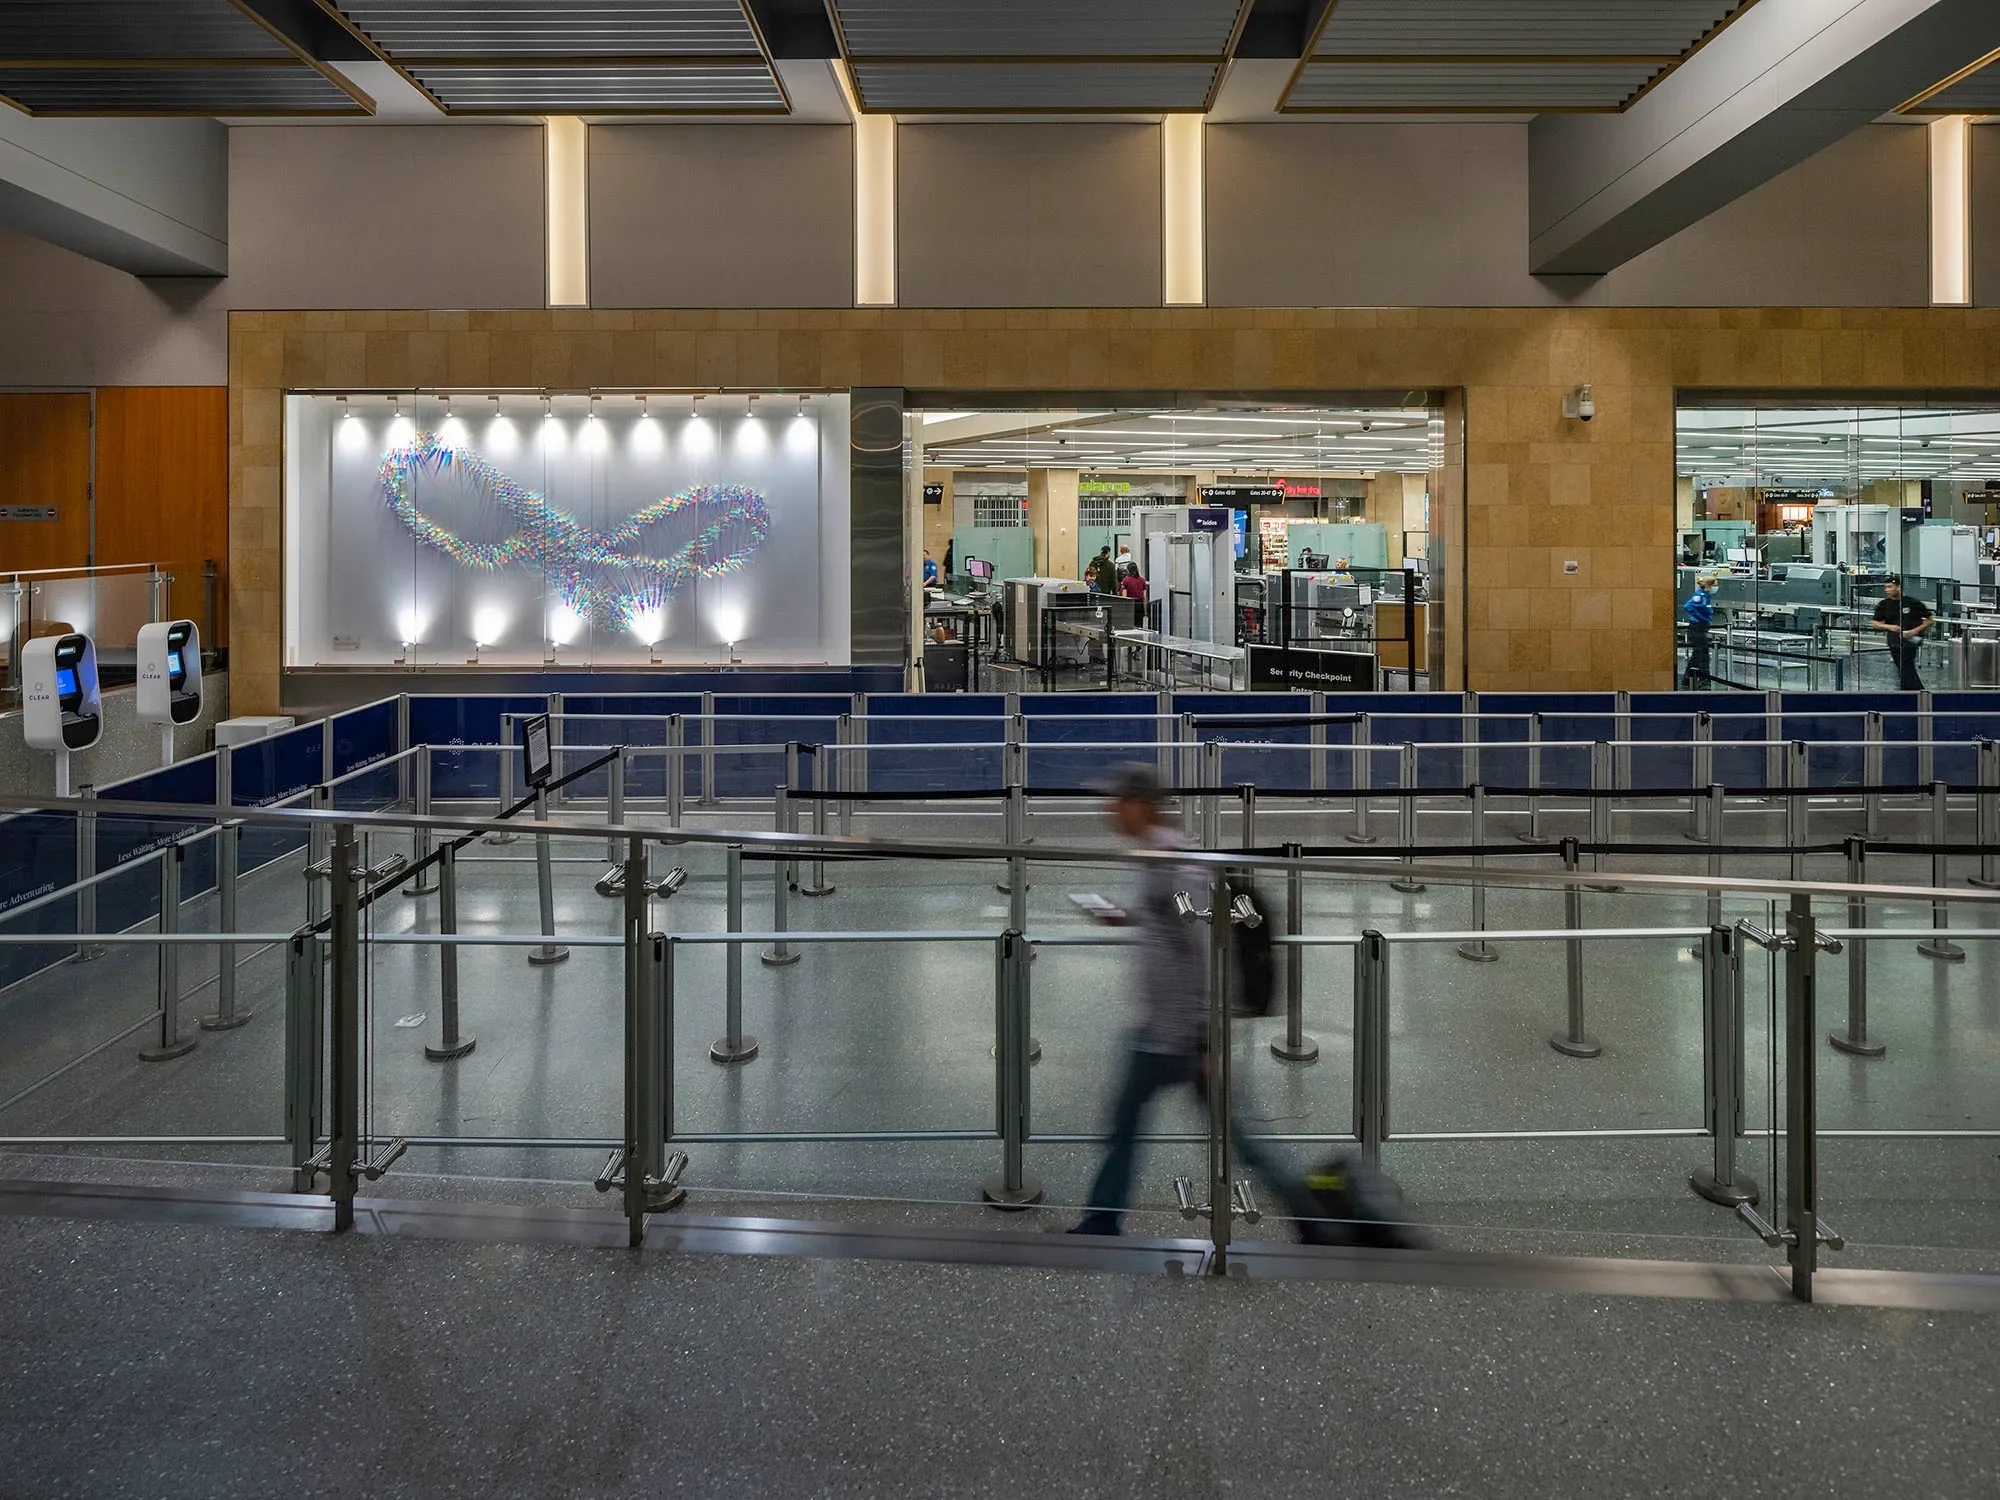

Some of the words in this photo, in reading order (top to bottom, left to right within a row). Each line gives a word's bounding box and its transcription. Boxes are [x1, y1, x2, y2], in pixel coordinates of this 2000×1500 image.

[1078, 479, 1131, 492] alance
[1269, 667, 1303, 679] Secrity
[1304, 671, 1352, 682] Checkpoint
[118, 850, 133, 862] Less
[156, 837, 172, 848] More
[171, 825, 198, 841] Exploring
[9, 881, 56, 907] Adventuring
